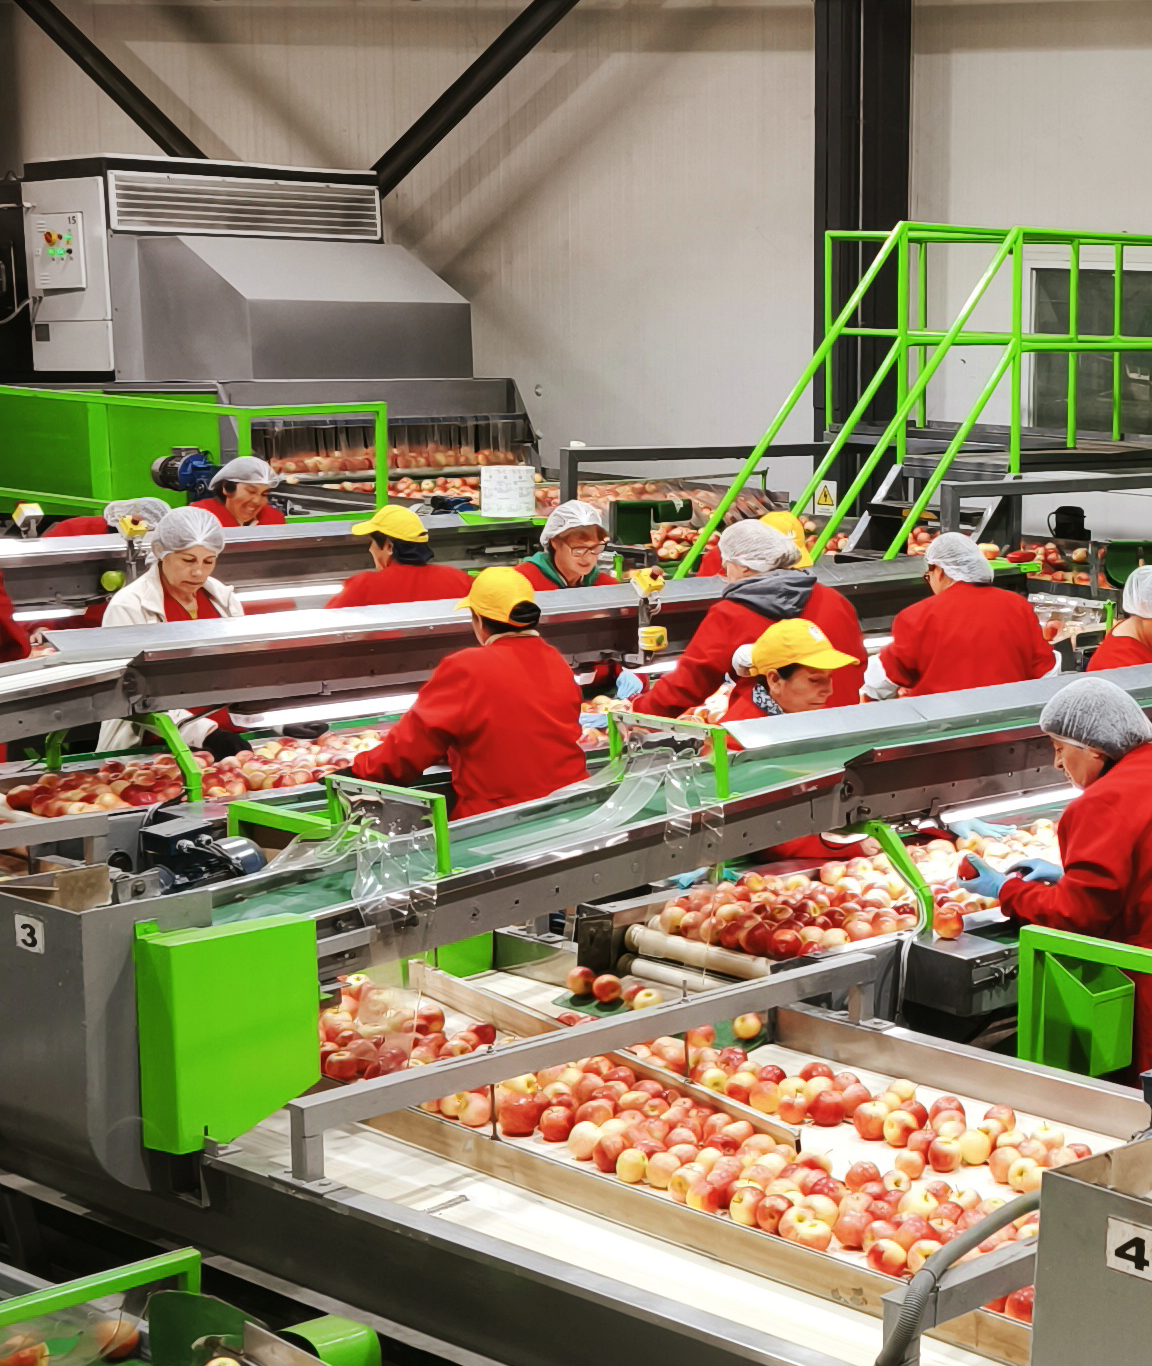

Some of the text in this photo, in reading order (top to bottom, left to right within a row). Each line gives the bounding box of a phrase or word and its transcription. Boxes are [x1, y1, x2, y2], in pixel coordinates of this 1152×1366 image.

[67, 215, 77, 225] 15
[20, 923, 38, 948] 3
[1114, 1236, 1150, 1272] 4
